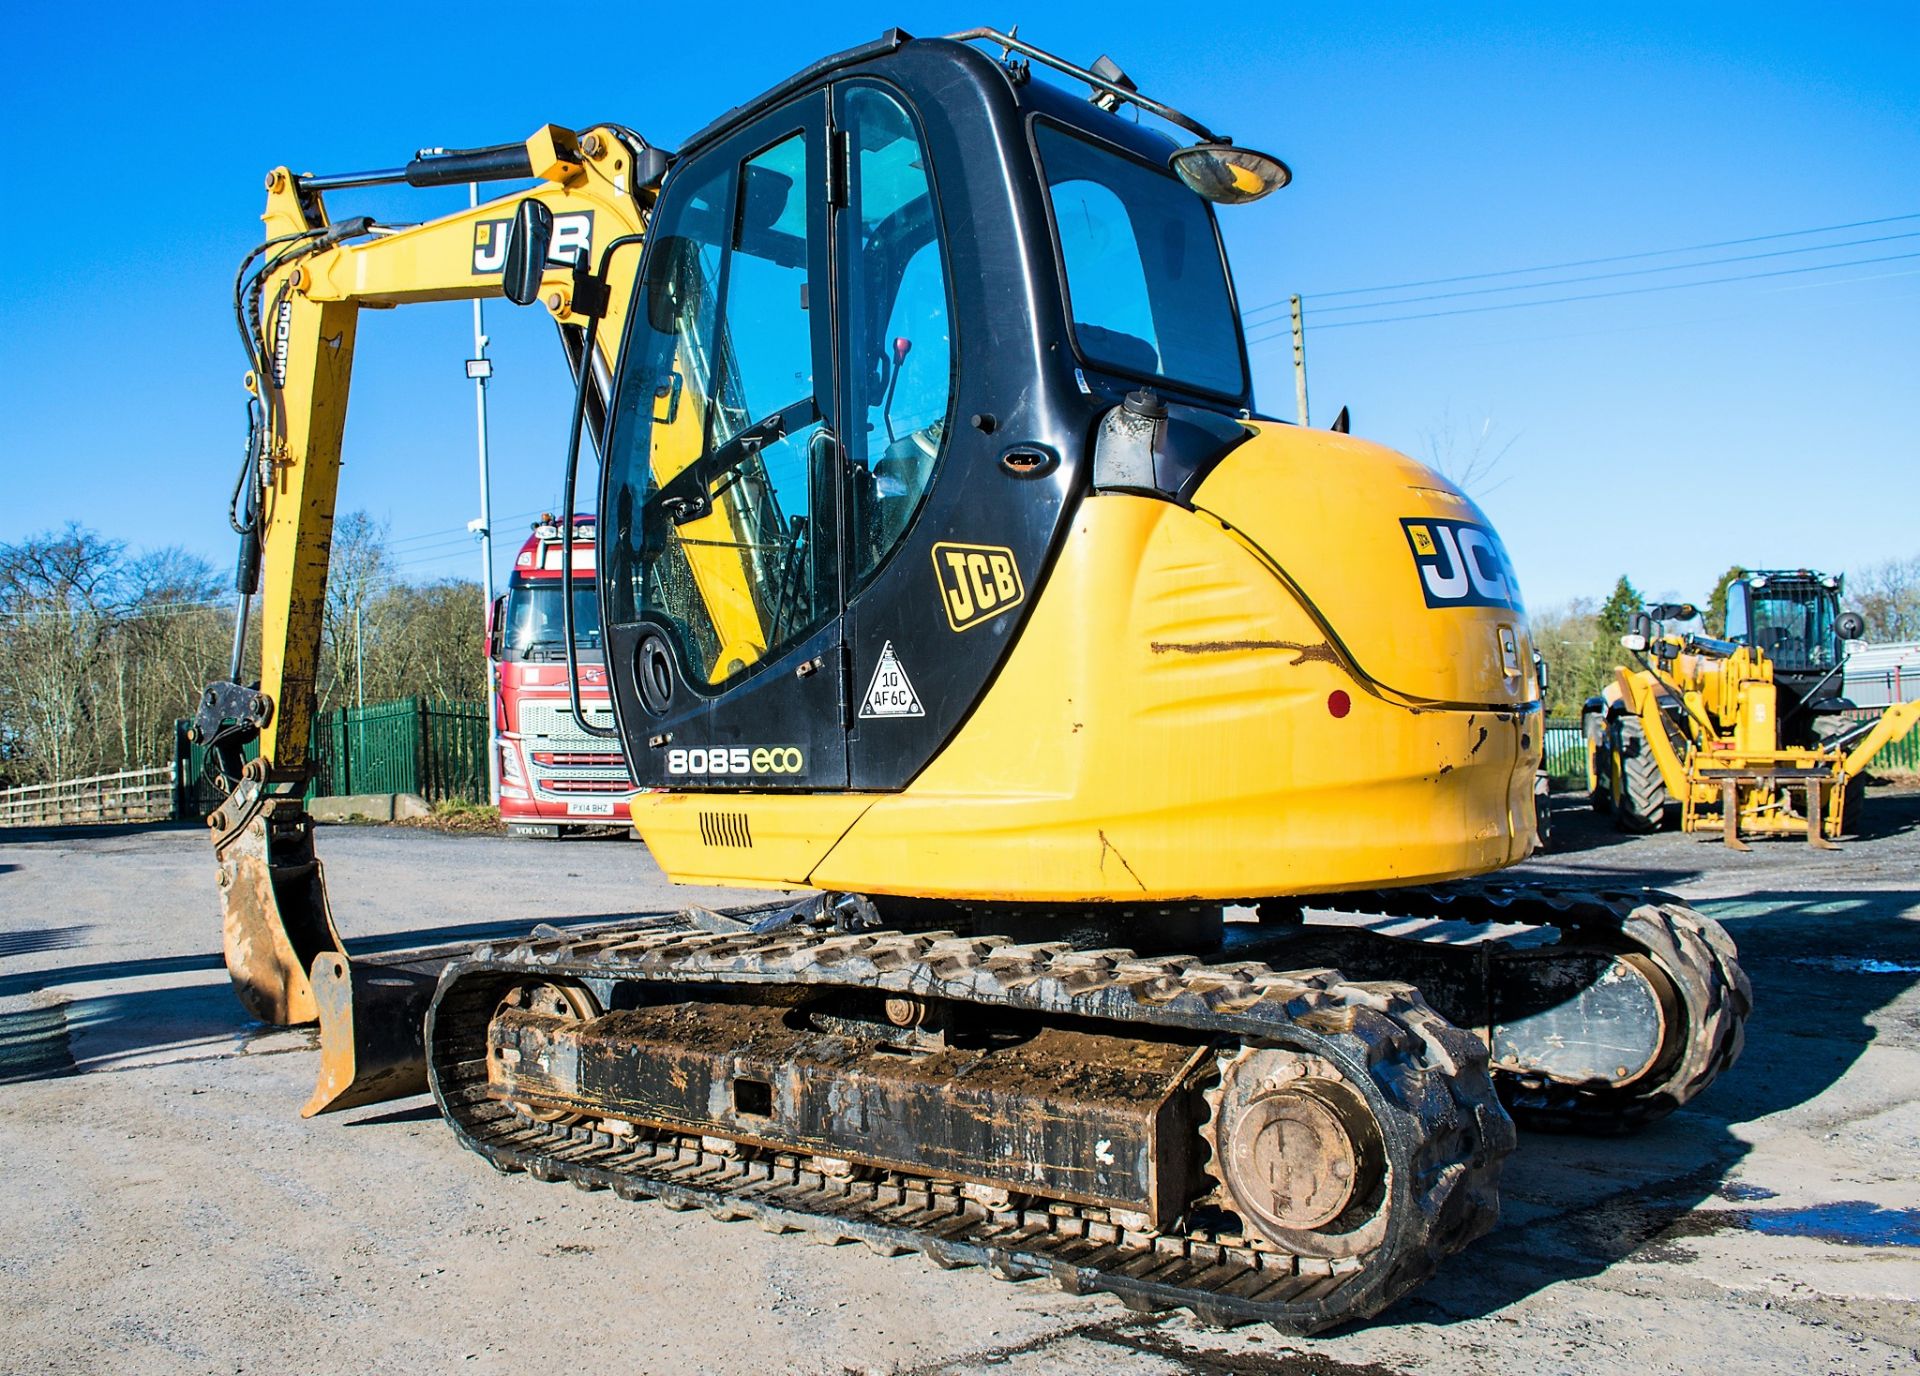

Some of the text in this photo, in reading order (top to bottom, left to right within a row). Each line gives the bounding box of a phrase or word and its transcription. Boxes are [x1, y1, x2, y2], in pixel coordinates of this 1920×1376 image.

[474, 214, 591, 271] JB
[945, 552, 1016, 621] JCB
[882, 672, 898, 688] 10
[874, 690, 907, 707] AF6C
[573, 803, 608, 813] PX14 BHZ
[515, 827, 548, 835] VOLVO
